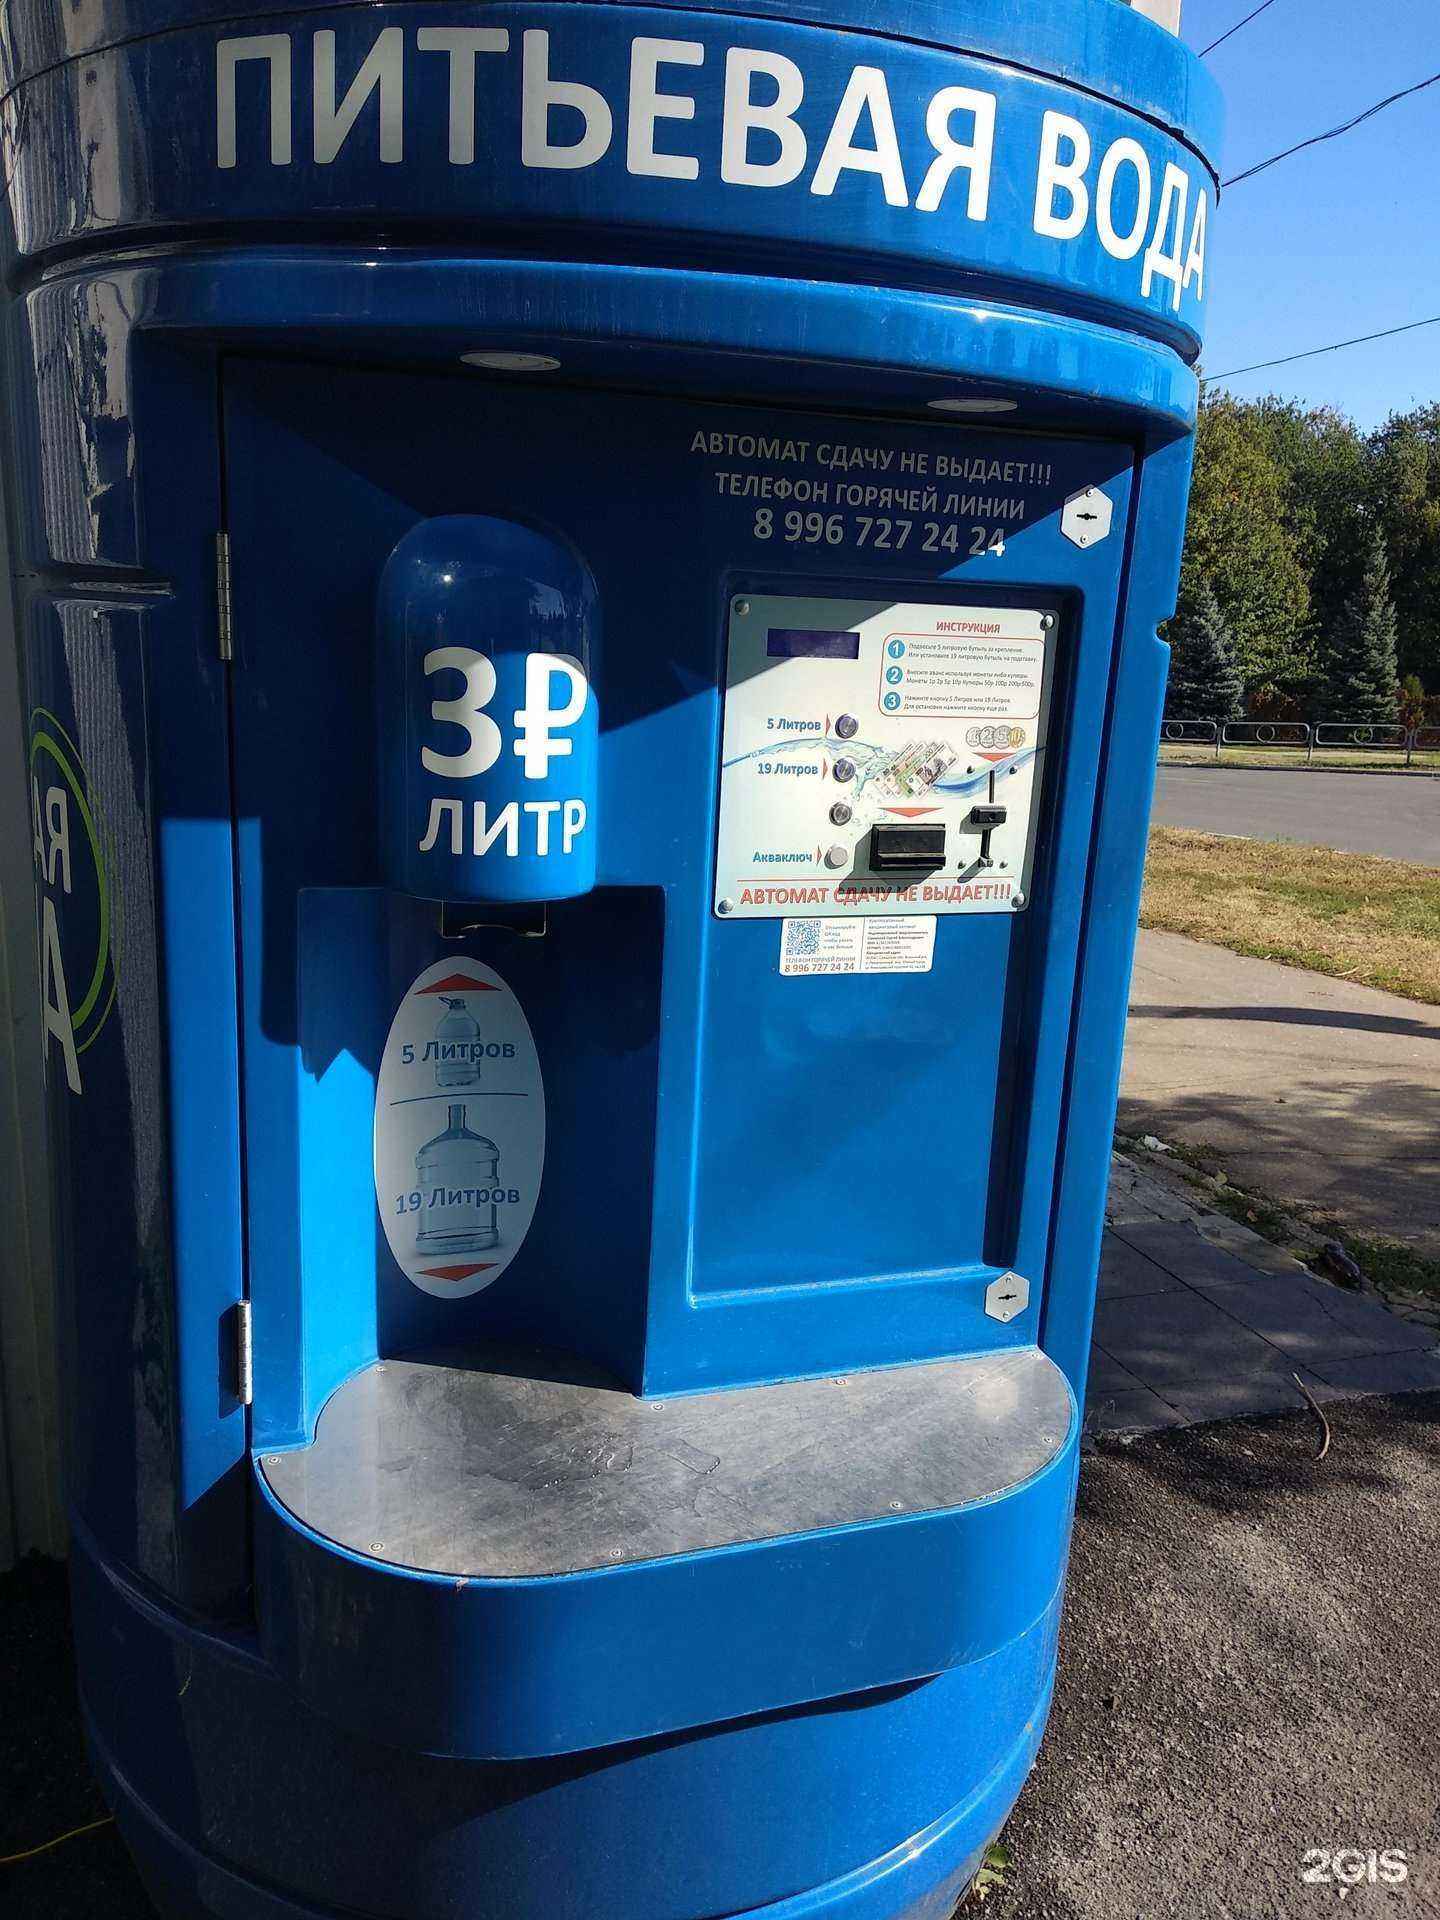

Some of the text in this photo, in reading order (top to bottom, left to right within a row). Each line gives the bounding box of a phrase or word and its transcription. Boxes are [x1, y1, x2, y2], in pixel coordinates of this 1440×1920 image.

[215, 27, 1207, 312] ПИТЬЕВАЯ ВОДА
[690, 430, 1052, 486] АВТОМАТ СДАЧУ НЕ ВЫДАЕТ!!!
[715, 471, 1025, 520] ТЕЛЕФОН ГОРЯЧЕЙ ЛИНИИ
[753, 508, 1006, 557] 8 996 727 24 24
[936, 621, 1000, 634] ИНСТРУКЦИЯ
[766, 718, 821, 732] 5 Литров
[758, 763, 818, 777] 19 Литров
[419, 798, 587, 857] ЛИТР
[752, 851, 812, 863] Акваключ
[740, 883, 1011, 906] АВТОМАТ СДАЧУ НЕ ВЫДАЕТ!!!
[785, 962, 854, 972] 8 996 727 24 24
[401, 1040, 516, 1064] 5 Литров
[395, 1186, 520, 1215] 19 Литров
